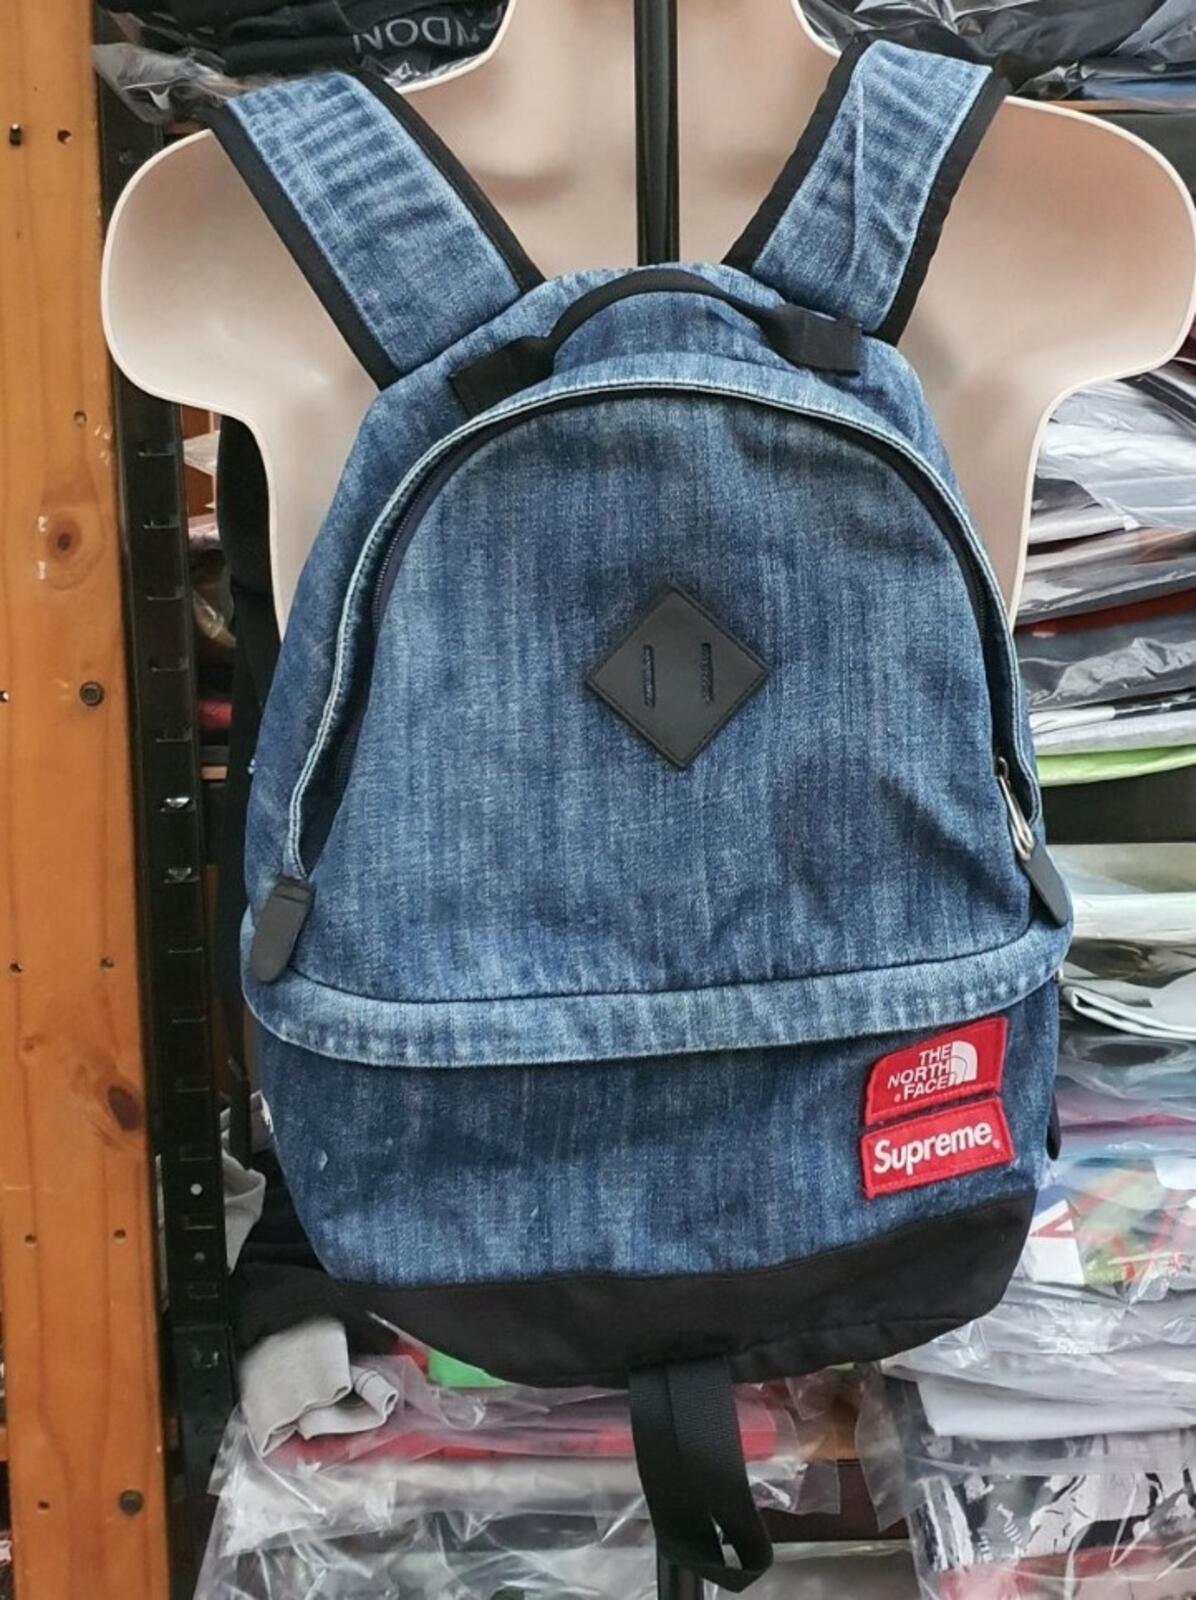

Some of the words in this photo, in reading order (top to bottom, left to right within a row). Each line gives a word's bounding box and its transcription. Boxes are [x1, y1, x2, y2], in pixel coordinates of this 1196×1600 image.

[919, 1043, 952, 1066] THE
[887, 1059, 950, 1089] NORTH
[903, 1075, 949, 1101] FACE
[873, 1121, 993, 1176] Supreme
